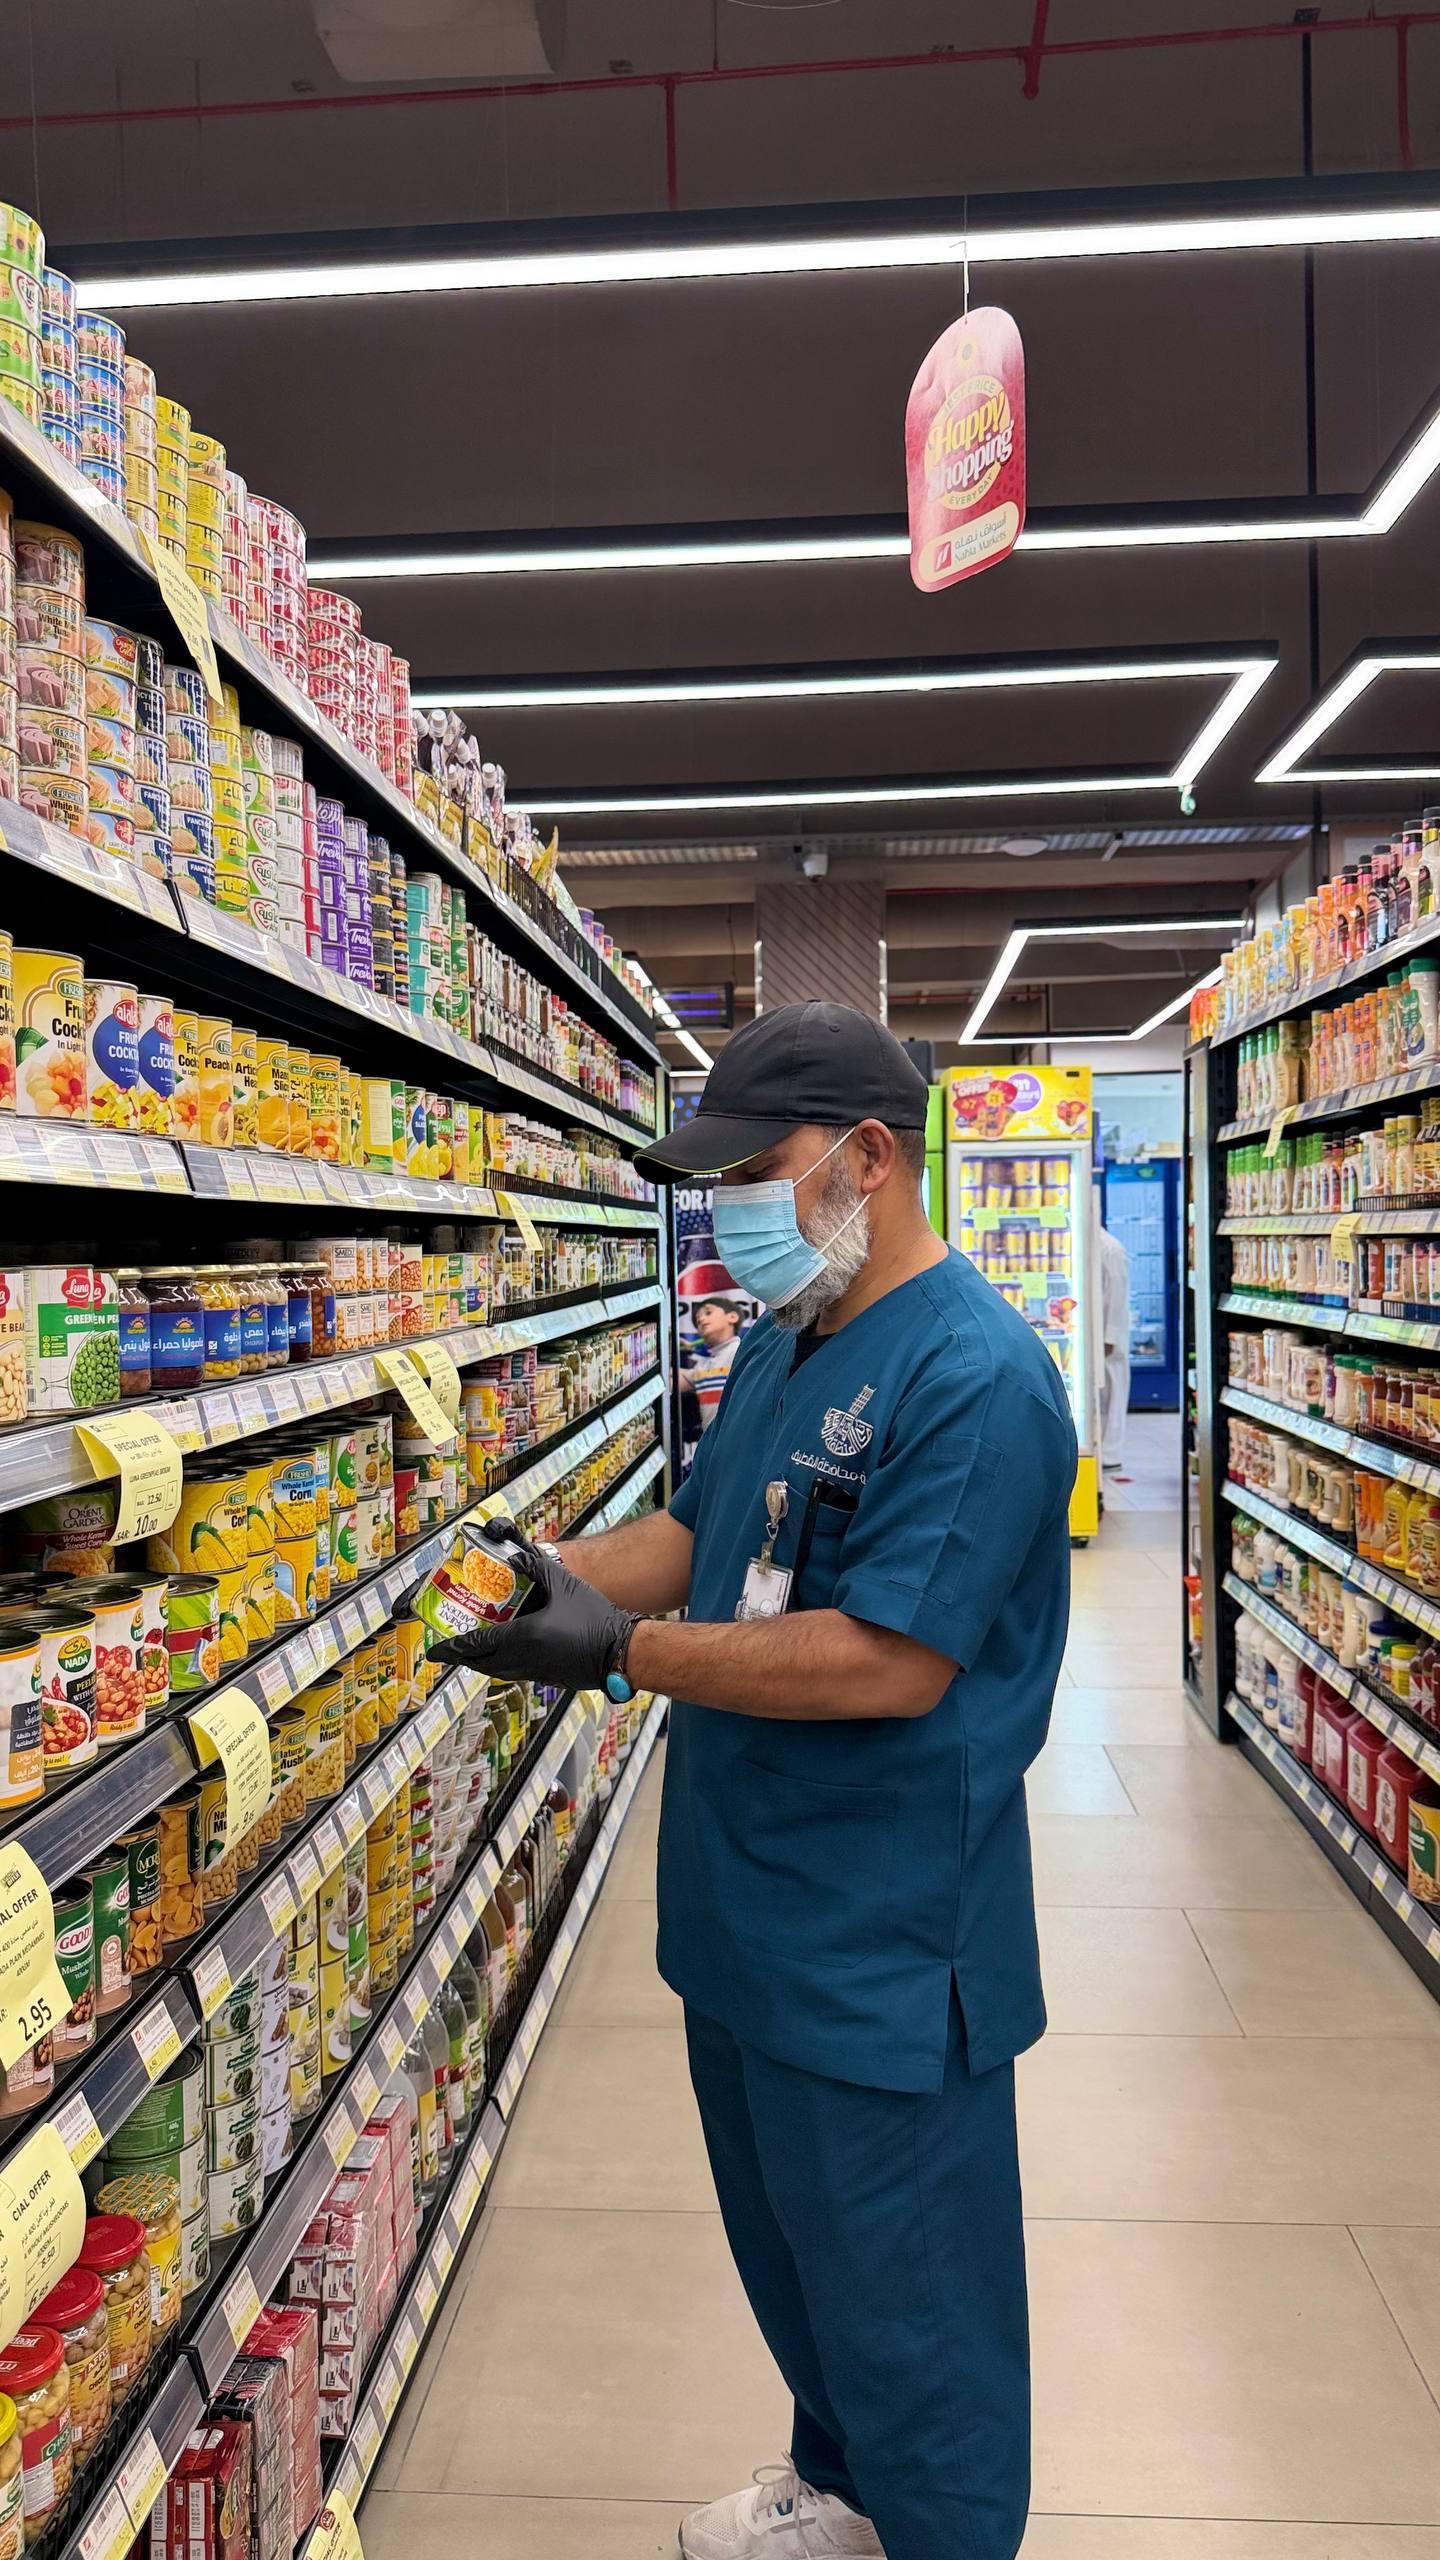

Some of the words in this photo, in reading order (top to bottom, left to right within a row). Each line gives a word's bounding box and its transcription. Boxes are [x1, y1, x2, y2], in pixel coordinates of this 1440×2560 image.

[928, 391, 1005, 463] Happy
[950, 488, 977, 505] EVERY
[978, 474, 993, 495] DAY
[50, 800, 72, 812] White
[63, 809, 79, 822] Tuna
[57, 1041, 65, 1050] In
[66, 1041, 81, 1052] Light
[205, 1057, 230, 1070] Peach
[67, 1277, 91, 1299] Luna
[114, 1439, 140, 1452] SPECIAL
[140, 1434, 162, 1447] OFFER
[290, 1489, 312, 1501] Corn
[63, 1516, 105, 1530] GARDENS
[69, 1505, 103, 1520] ORIENT
[134, 1514, 158, 1538] 10.00
[439, 1609, 470, 1634] ORIENT
[440, 1599, 479, 1628] GARDENS
[64, 1654, 89, 1670] NADA
[226, 1735, 244, 1756] SPECIAL
[243, 1721, 257, 1739] OFFER
[13, 1888, 39, 1914] OFFER
[18, 1997, 52, 2042] 2.95
[12, 2199, 30, 2222] CIAL
[28, 2169, 52, 2200] OFFER
